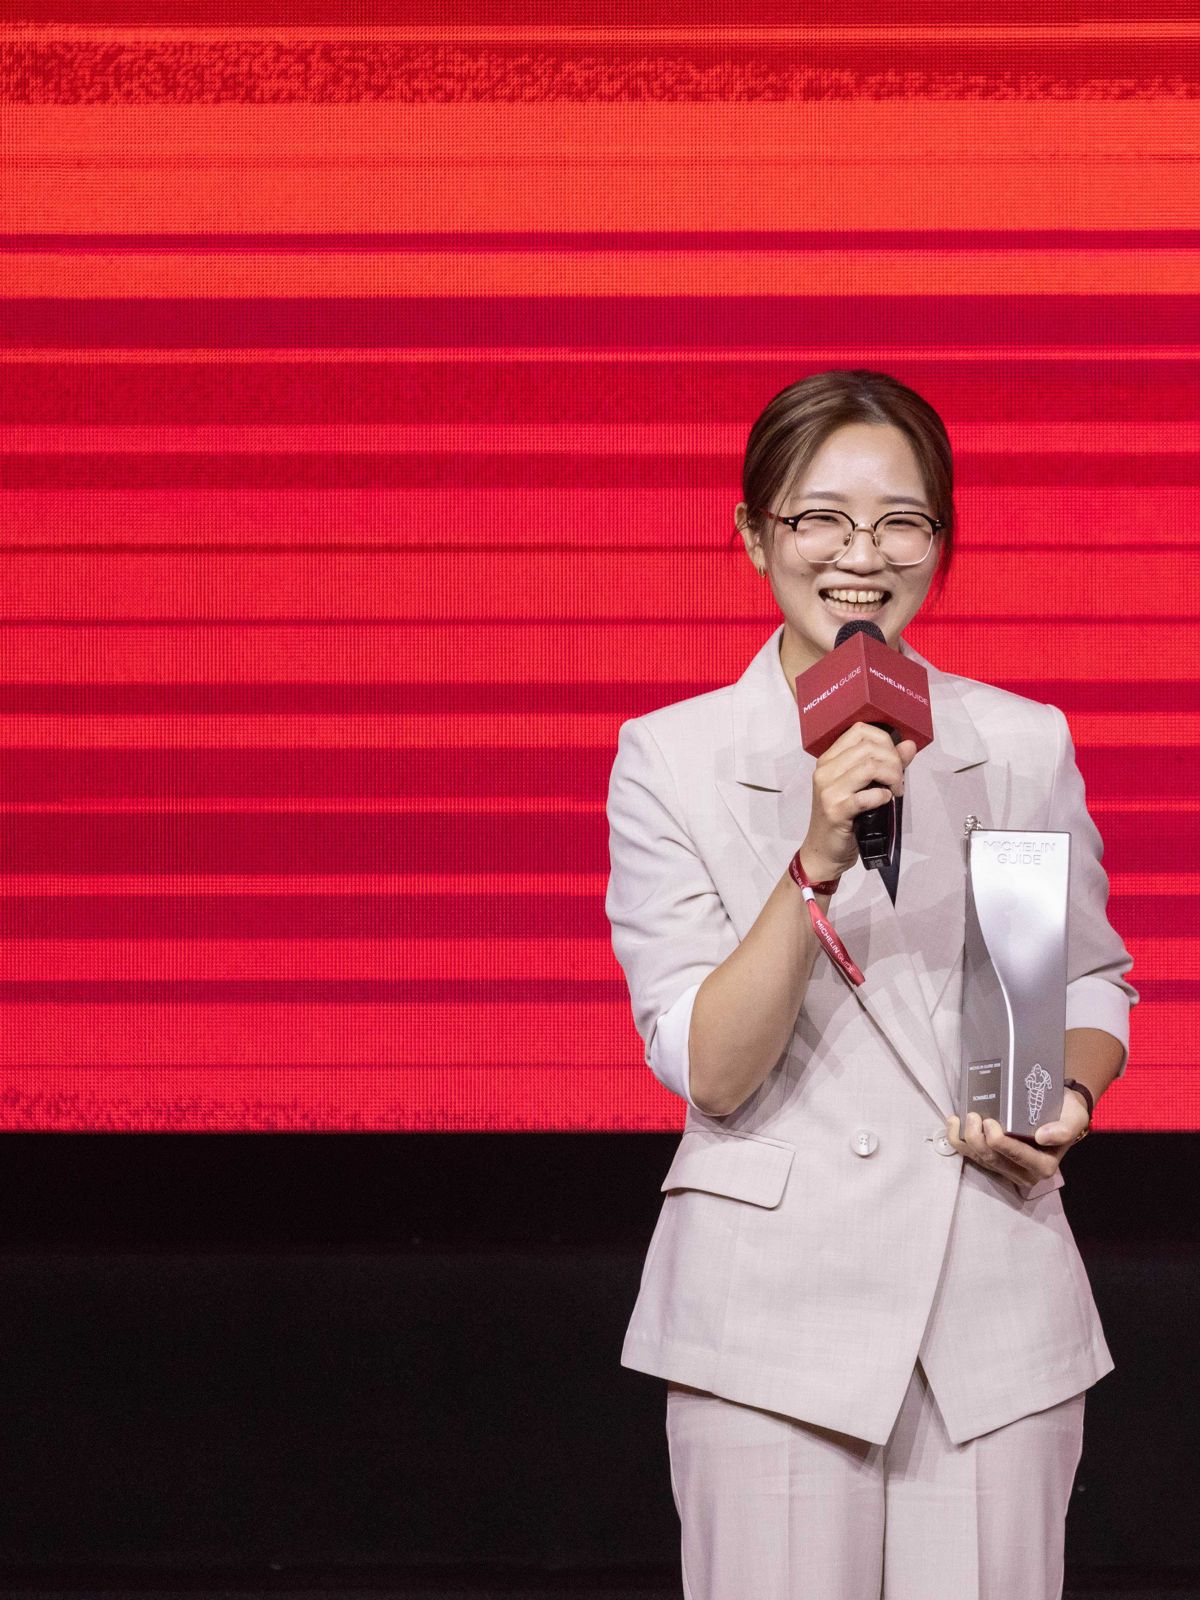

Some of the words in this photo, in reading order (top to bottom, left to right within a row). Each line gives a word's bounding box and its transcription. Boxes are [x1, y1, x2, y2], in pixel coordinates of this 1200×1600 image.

[803, 683, 838, 714] MICHELIN
[838, 666, 862, 688] GUIDE
[869, 666, 906, 693] MICHELIN
[905, 687, 929, 706] GUIDE
[983, 840, 1056, 853] MICHELIN
[997, 853, 1042, 865] GUIDE
[815, 919, 840, 954] MICHELIN
[837, 952, 856, 975] GUIDE
